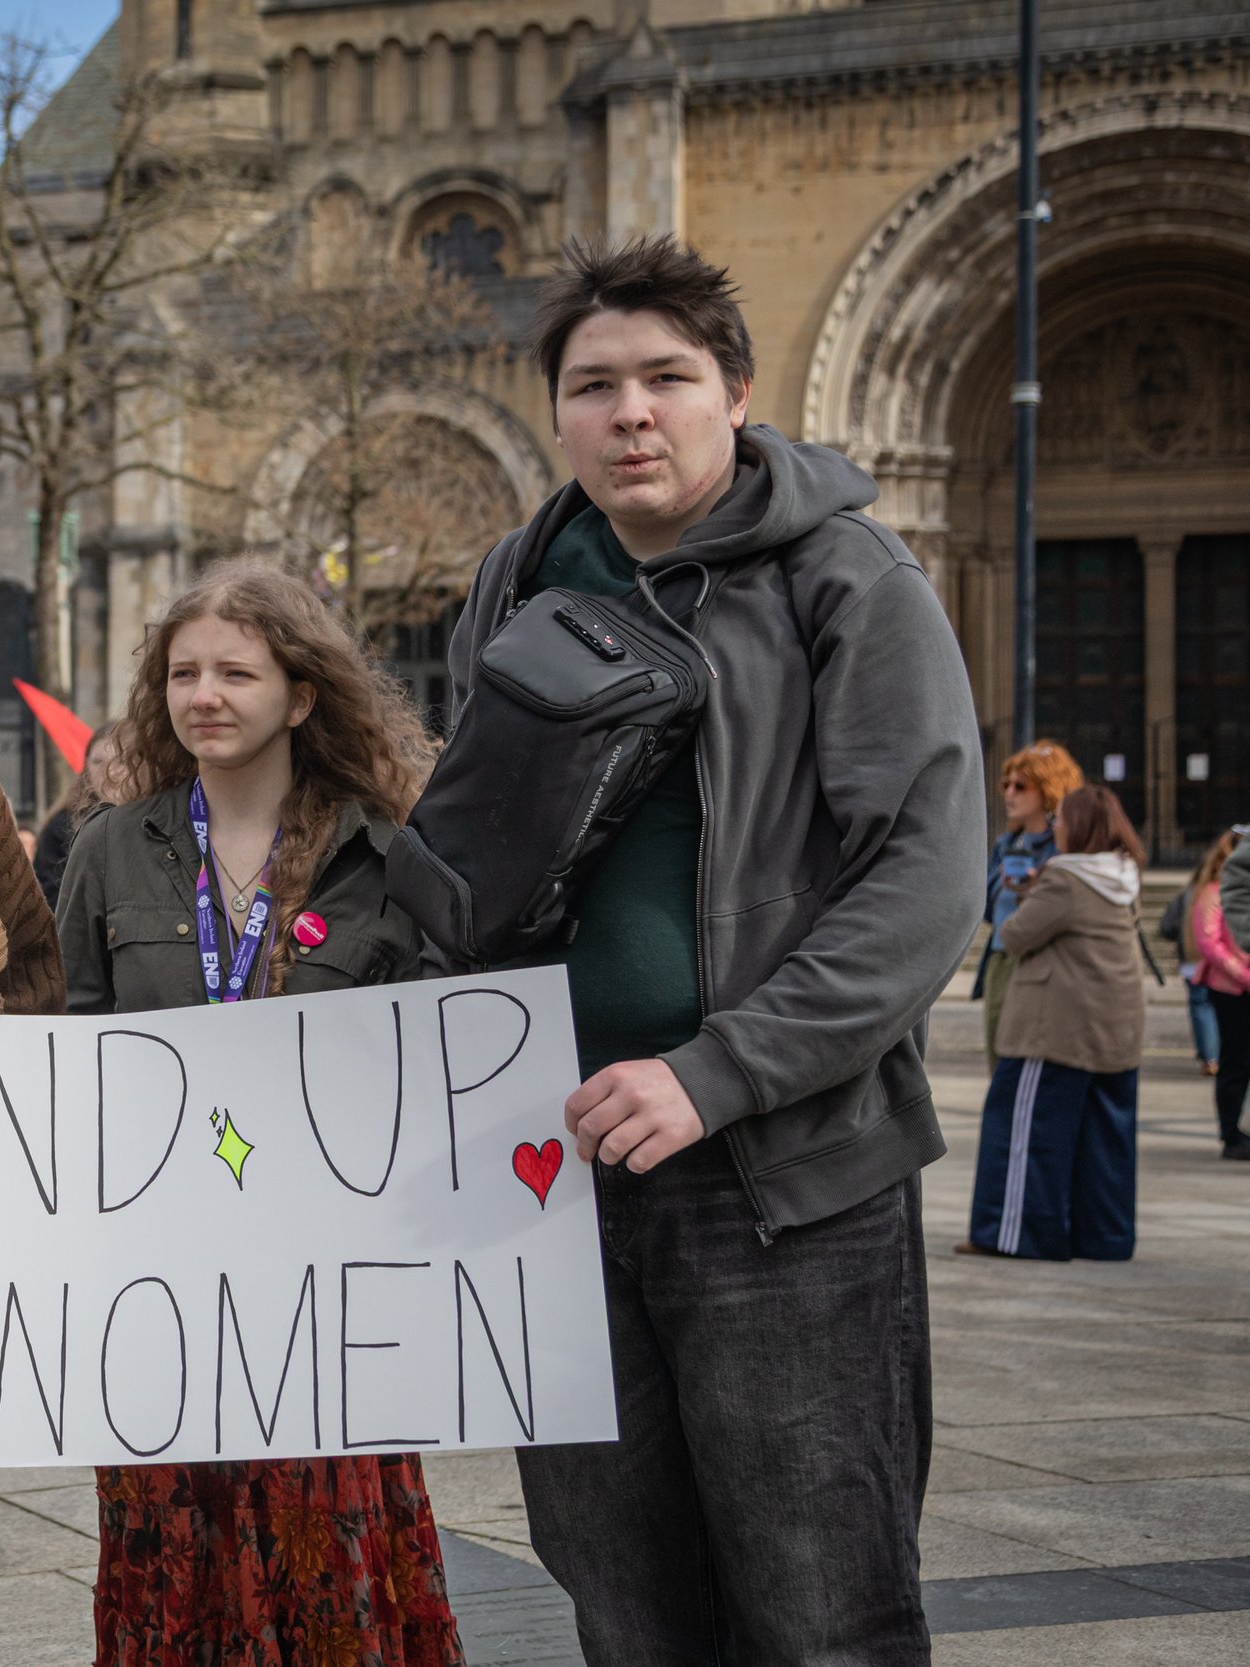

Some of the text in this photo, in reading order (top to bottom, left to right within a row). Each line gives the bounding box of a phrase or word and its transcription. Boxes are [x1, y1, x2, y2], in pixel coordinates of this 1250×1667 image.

[602, 745, 622, 783] FUTURE
[244, 901, 268, 938] END
[202, 952, 220, 990] END
[297, 988, 532, 1197] UP
